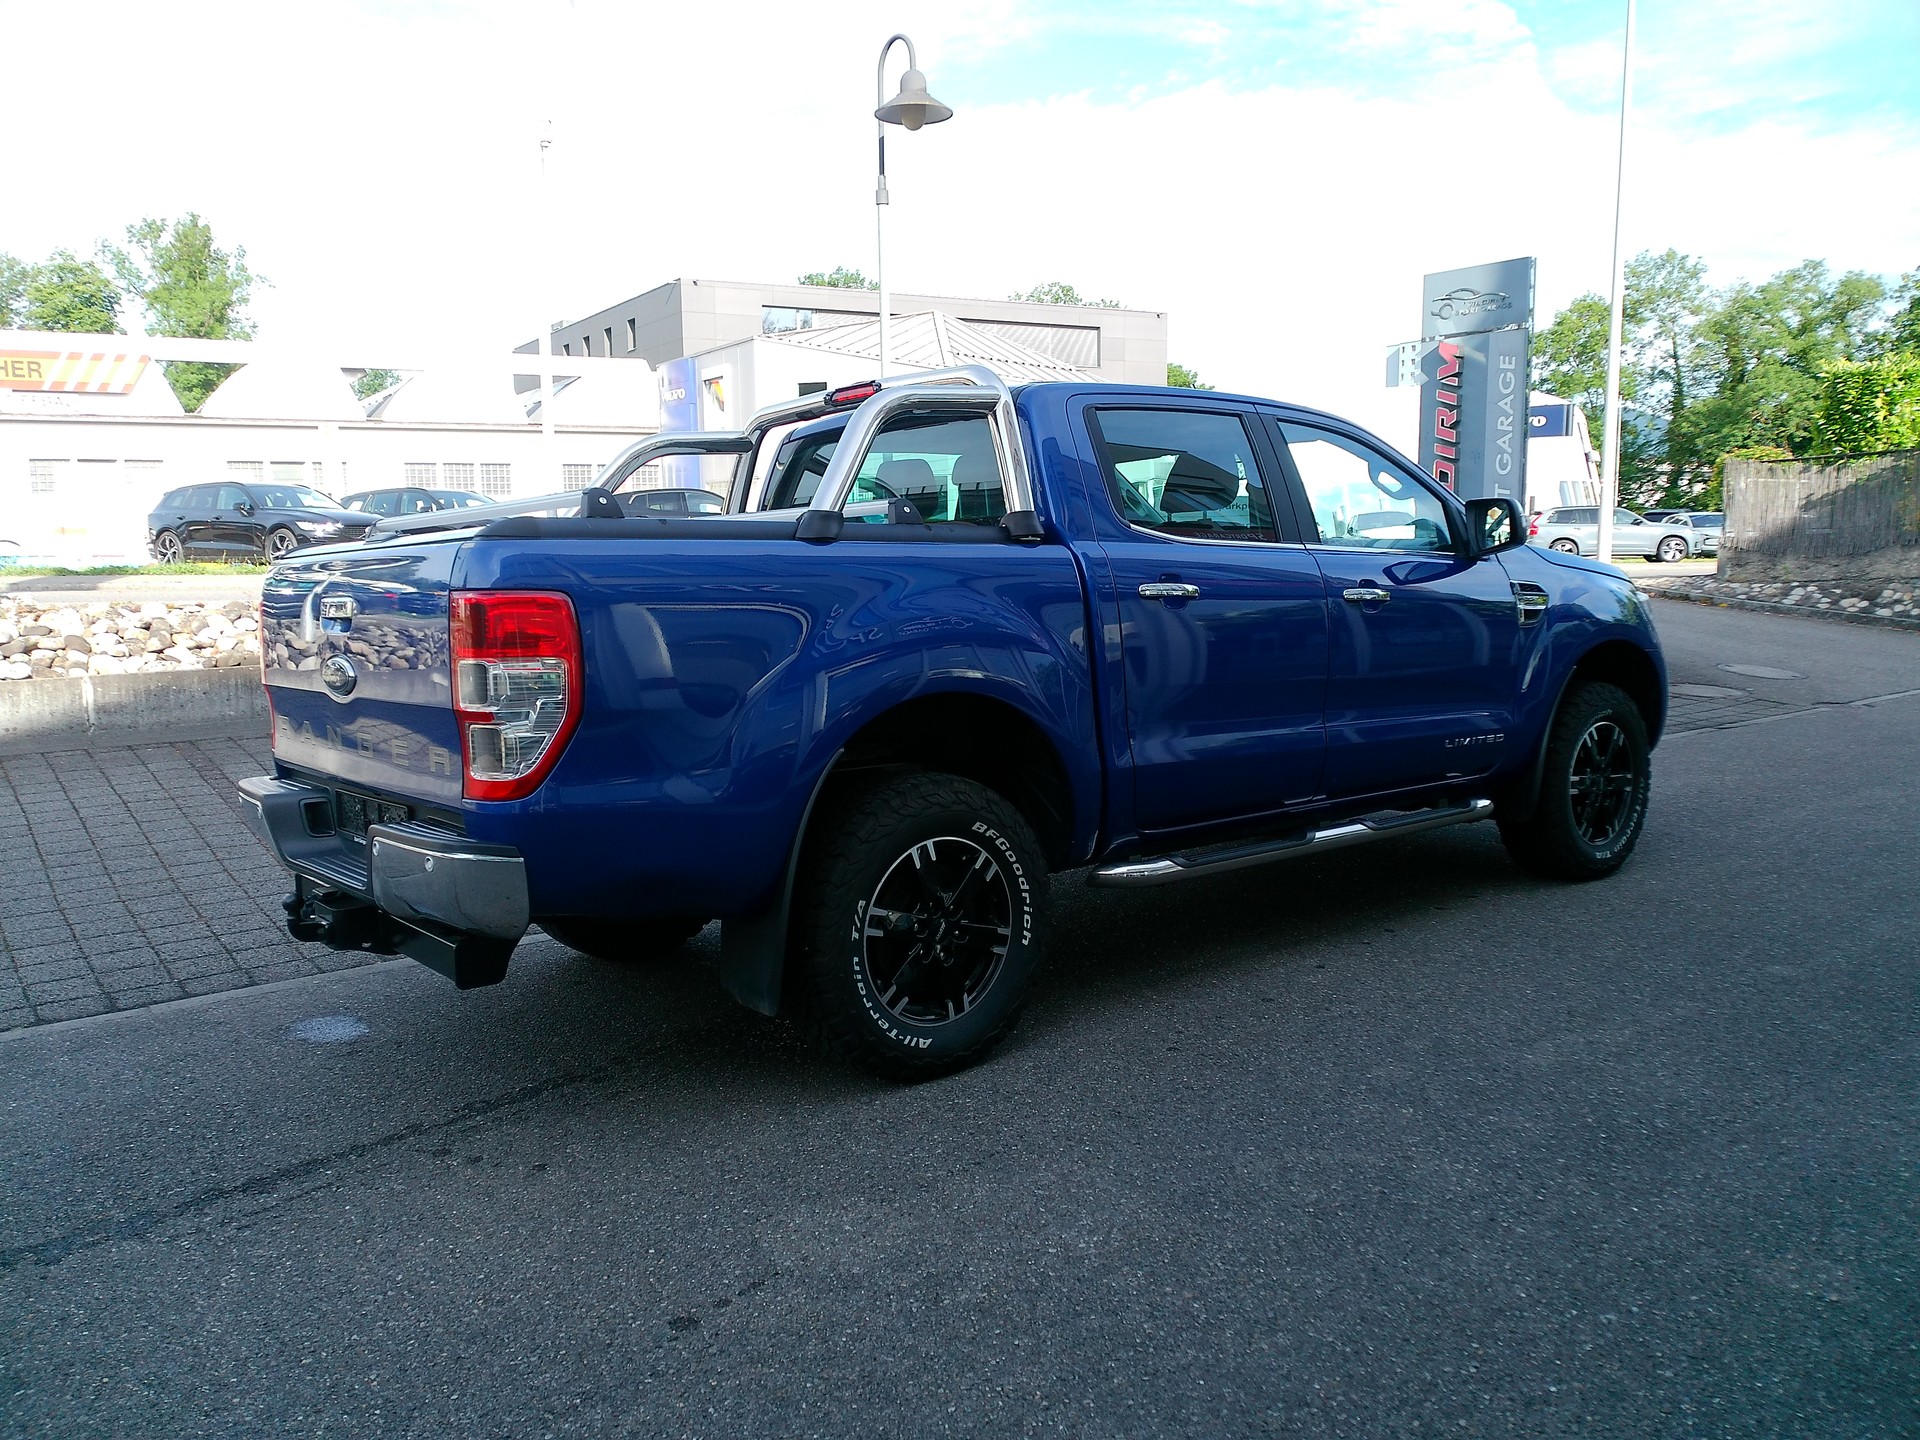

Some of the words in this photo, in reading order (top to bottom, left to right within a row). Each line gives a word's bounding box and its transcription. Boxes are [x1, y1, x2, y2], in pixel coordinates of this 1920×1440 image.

[1495, 355, 1516, 475] GARAGE
[277, 715, 451, 776] RANGER
[1445, 733, 1504, 748] LIMITED
[851, 899, 867, 942] T/A
[971, 821, 1034, 946] BFGoodrich
[852, 956, 934, 1049] All-Terrain
